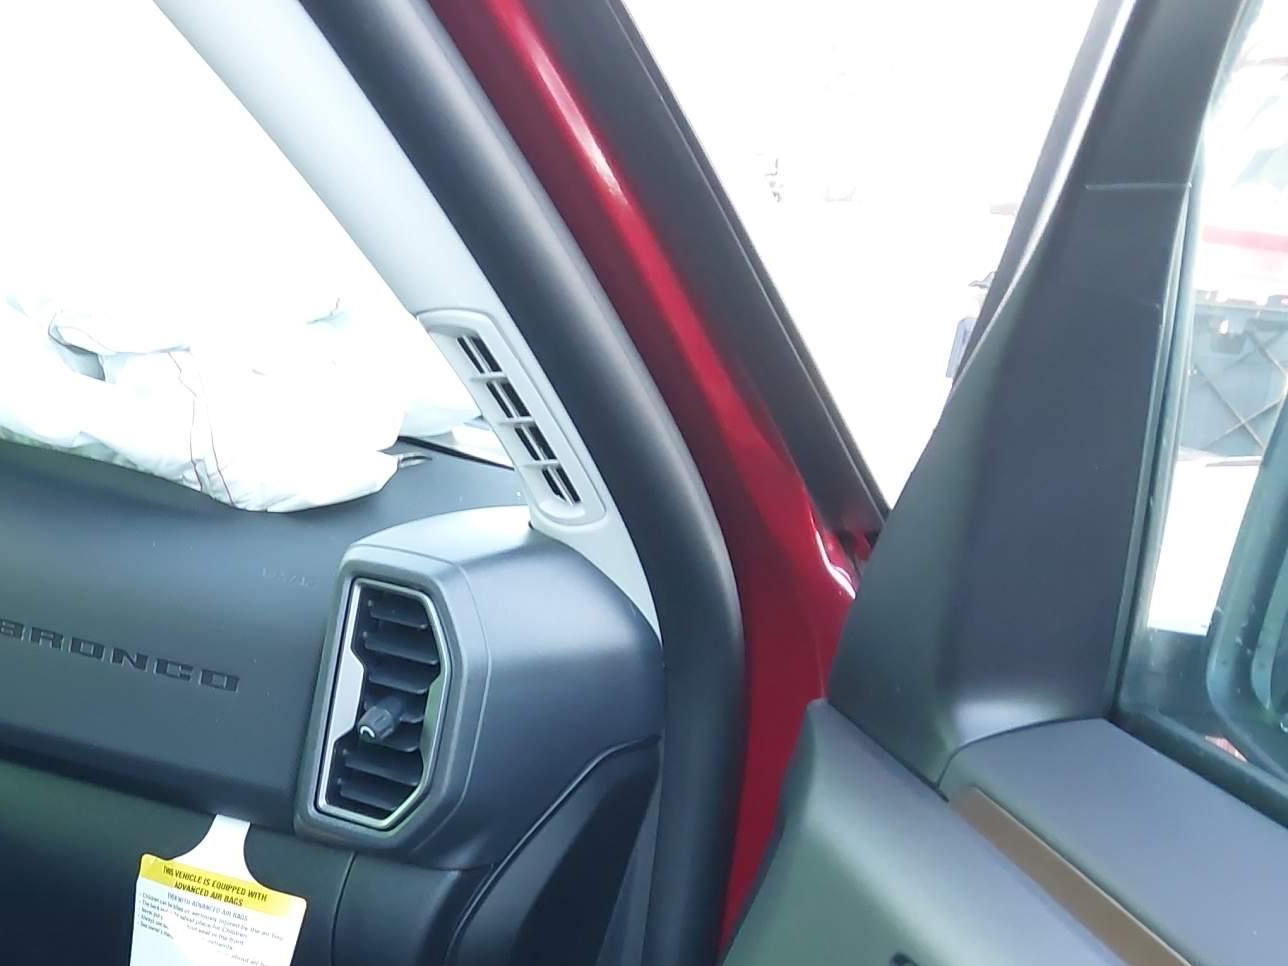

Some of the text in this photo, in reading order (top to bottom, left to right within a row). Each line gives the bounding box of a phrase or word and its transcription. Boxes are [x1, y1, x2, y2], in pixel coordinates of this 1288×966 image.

[163, 865, 268, 902] THIS VEHICLE IS EQUIPPED WITH
[174, 881, 244, 907] ADVANCED AIR BAGS
[192, 900, 220, 913] ADVANCED
[233, 911, 248, 921] BAGS
